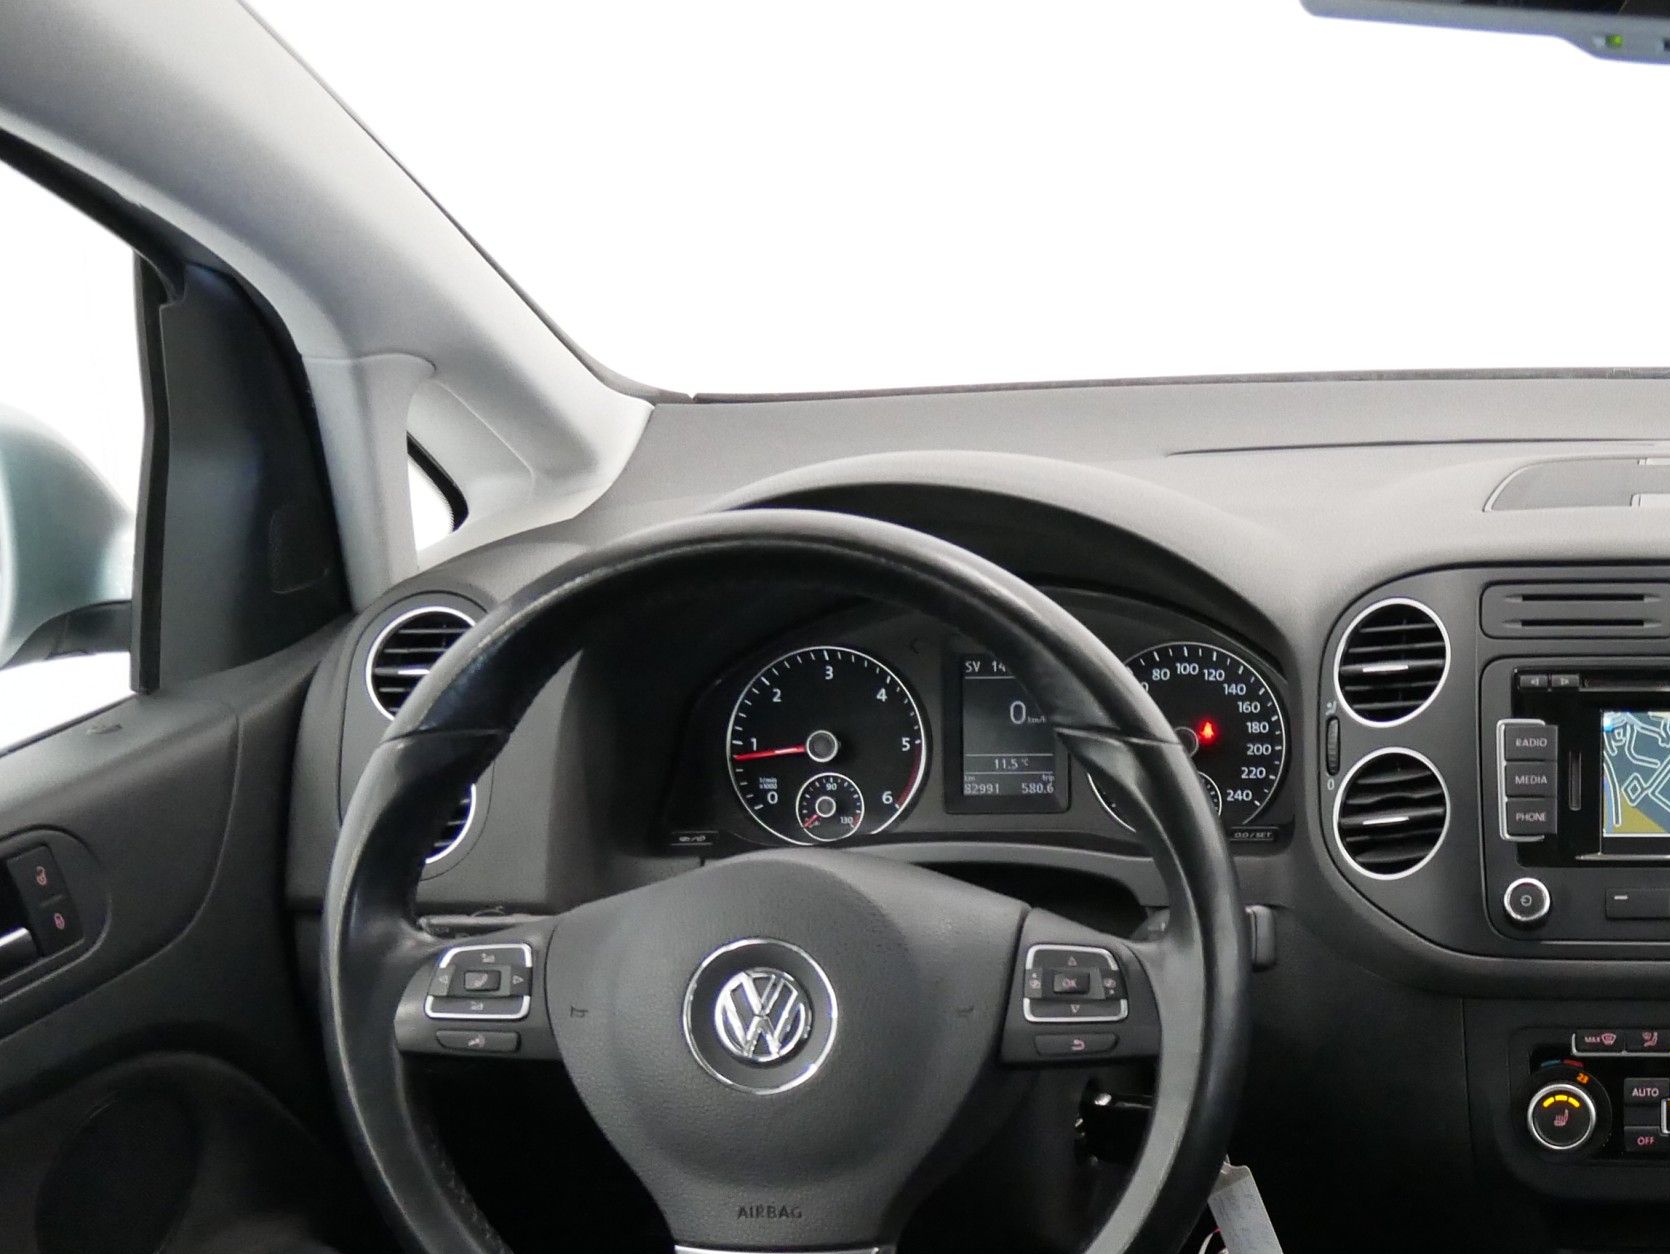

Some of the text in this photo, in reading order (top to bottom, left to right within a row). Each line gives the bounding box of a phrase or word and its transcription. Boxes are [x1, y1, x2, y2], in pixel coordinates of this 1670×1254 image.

[825, 665, 834, 680] 3
[965, 661, 981, 673] SV
[1176, 663, 1199, 675] 100
[1152, 668, 1170, 680] 80
[1204, 669, 1225, 681] 120
[876, 688, 887, 702] 4
[1223, 683, 1246, 695] 140
[772, 689, 782, 702] 2
[1010, 700, 1026, 725] 0
[1237, 701, 1260, 713] 160
[1246, 722, 1269, 734] 180
[750, 738, 757, 751] 1
[902, 737, 910, 751] 5
[1515, 738, 1548, 747] RADIO
[1247, 744, 1271, 756] 200
[994, 758, 1019, 769] 11.5
[1241, 767, 1266, 779] 220
[1515, 775, 1548, 784] MEDIA
[826, 782, 837, 791] 90
[964, 783, 1000, 794] 82991
[1021, 782, 1054, 794] 580.6
[767, 792, 778, 804] 0
[882, 791, 893, 804] 6
[1227, 789, 1252, 801] 240
[1516, 812, 1547, 822] PHONE
[1632, 1088, 1659, 1098] AUTO
[1637, 1137, 1655, 1146] OFF
[737, 1207, 802, 1219] AIRBAG
